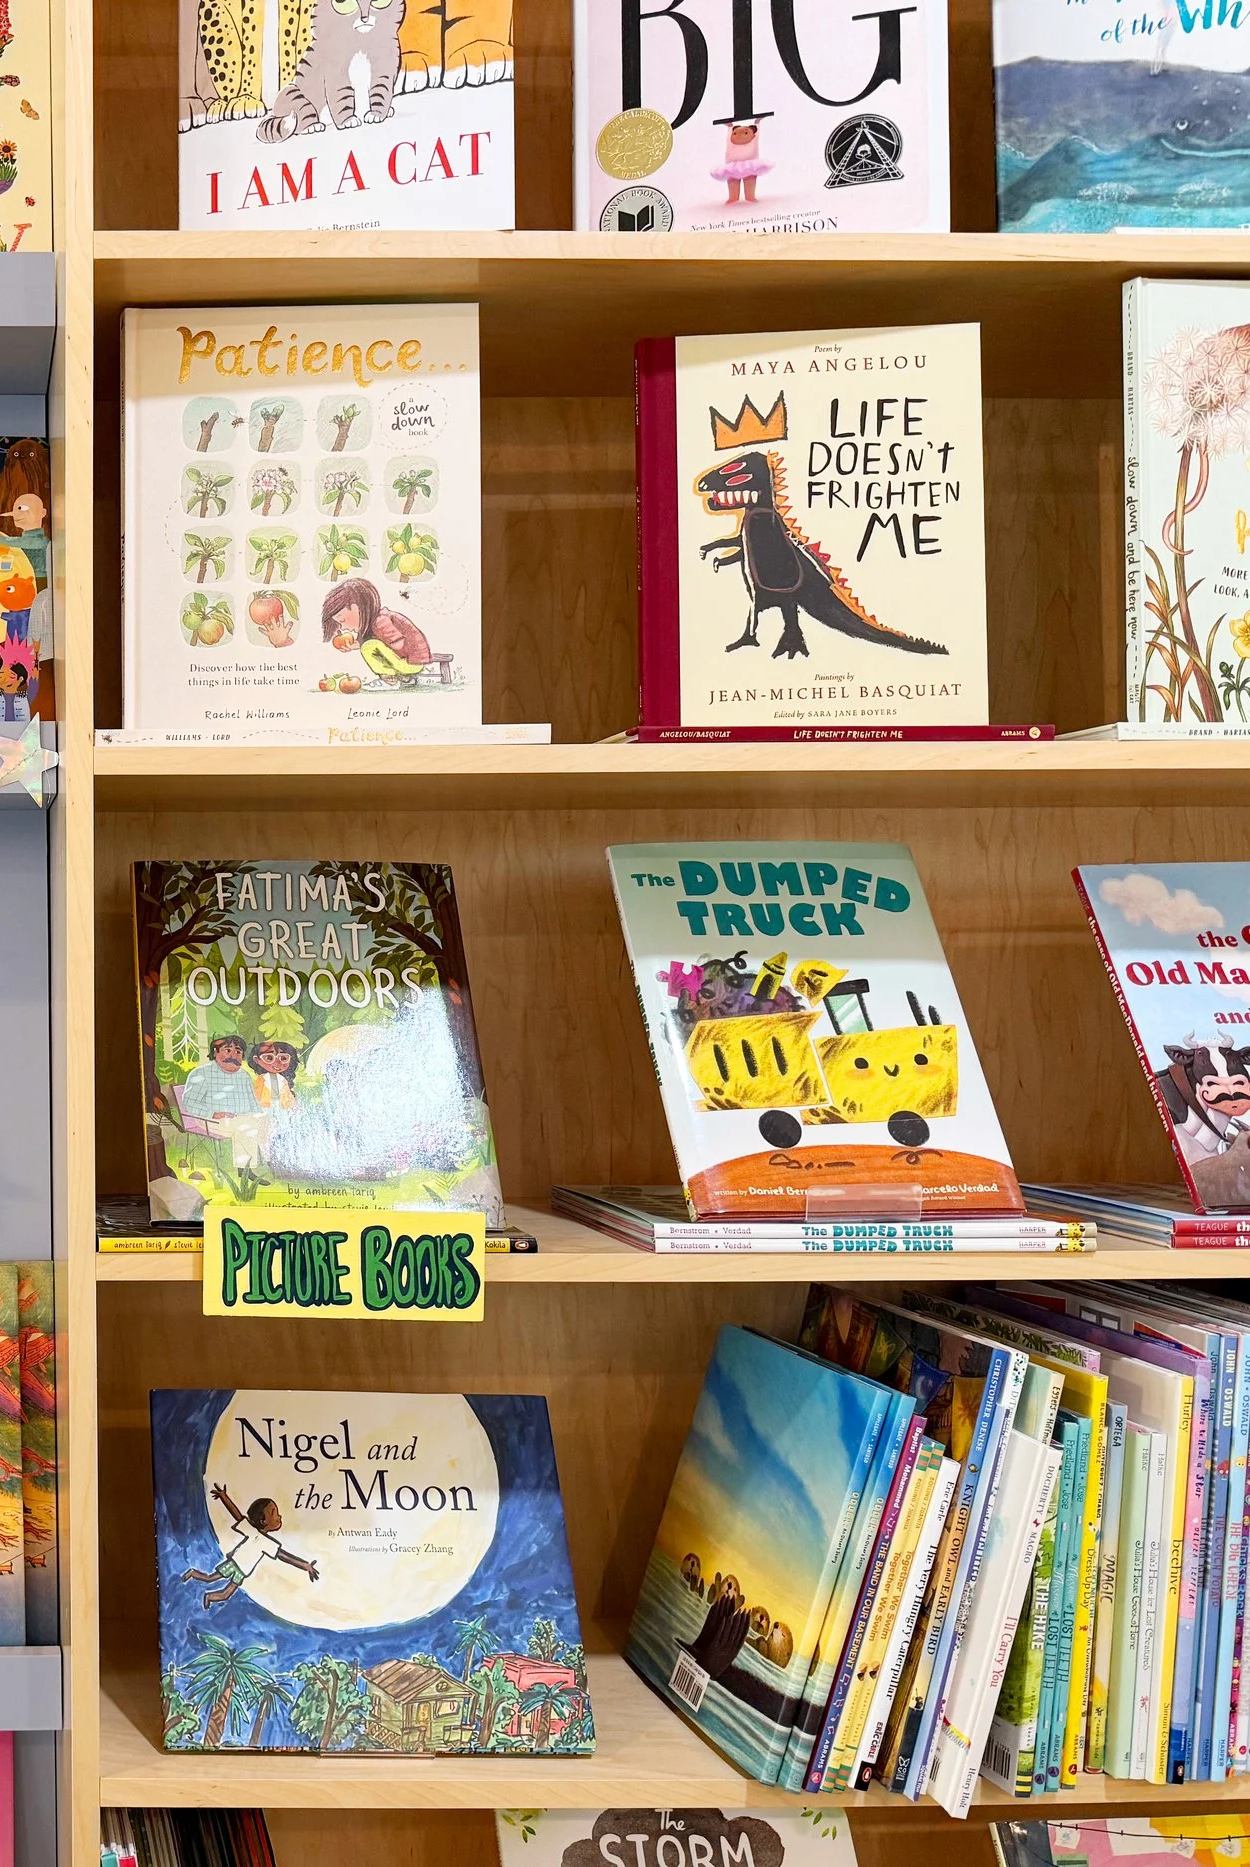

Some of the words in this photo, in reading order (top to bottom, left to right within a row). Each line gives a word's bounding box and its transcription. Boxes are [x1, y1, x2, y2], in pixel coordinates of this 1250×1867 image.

[1100, 18, 1127, 44] of
[1130, 13, 1173, 36] the
[206, 171, 223, 215] I
[237, 157, 318, 212] AM
[332, 149, 370, 195] A
[387, 131, 492, 186] CAT
[631, 189, 656, 199] BOOK
[751, 213, 791, 225] bestselling
[793, 210, 821, 219] creator
[814, 345, 833, 353] Poem
[833, 344, 843, 354] by
[731, 362, 796, 376] MAYA
[808, 355, 928, 373] ANGELOU
[393, 401, 430, 416] slow
[830, 397, 928, 438] LIFE
[391, 414, 435, 431] down
[408, 428, 429, 437] book
[808, 480, 960, 510] FRIGHTEN
[1126, 496, 1139, 537] down
[856, 512, 942, 562] ME
[1126, 542, 1141, 566] and
[1221, 566, 1249, 581] MORE
[189, 663, 233, 673] Discover
[188, 677, 219, 688] things
[708, 686, 850, 705] JEAN-MICHEL
[859, 683, 963, 700] BASQUIAT
[204, 709, 240, 720] Rachel
[347, 706, 381, 720] Leonie
[386, 706, 409, 720] Lord
[834, 709, 859, 718] JANE
[860, 708, 899, 717] BOYERS
[793, 730, 813, 740] LIFE
[847, 730, 888, 740] FRIGHTEN
[214, 871, 387, 913] FATIMA'S
[630, 873, 676, 887] The
[678, 860, 912, 913] DUMPED
[676, 901, 865, 937] TRUCK
[237, 919, 369, 962] GREAT
[1196, 930, 1239, 948] the
[1109, 973, 1120, 994] Old
[1125, 960, 1193, 986] Old
[187, 967, 425, 1010] OUTDOORS
[287, 1183, 300, 1199] by
[305, 1184, 348, 1197] ambreen
[958, 1183, 999, 1194] Verdad
[802, 1226, 828, 1236] The
[832, 1225, 898, 1238] DUMPED
[902, 1225, 954, 1237] TRUCK
[1194, 1222, 1229, 1231] TEAGUE
[114, 1240, 143, 1249] ambreen
[174, 1240, 193, 1249] stevie
[485, 1241, 506, 1249] Kokila
[670, 1241, 711, 1250] Bernstrom
[802, 1240, 828, 1251] The
[832, 1240, 898, 1252] DUMPED
[902, 1240, 954, 1252] TRUCK
[1193, 1237, 1227, 1246] TEAGUE
[220, 1218, 353, 1308] PICTURE
[360, 1225, 481, 1311] BOOKS
[985, 1358, 1003, 1418] CHRISTOPHER
[1179, 1394, 1193, 1433] Hurley
[1223, 1388, 1234, 1427] OSWALD
[975, 1421, 989, 1452] DENISE
[1112, 1415, 1124, 1447] ORTEGA
[235, 1417, 356, 1473] Nigel
[367, 1436, 418, 1461] and
[294, 1483, 333, 1510] the
[338, 1469, 478, 1512] Moon
[1037, 1465, 1055, 1516] DOCHERTY
[1195, 1473, 1205, 1498] Star
[956, 1482, 974, 1536] KNIGHT
[336, 1527, 372, 1538] Antwan
[389, 1543, 422, 1554] Gracey
[424, 1543, 454, 1555] Zhang
[870, 1559, 884, 1588] BAND
[1100, 1555, 1116, 1604] MAGIC
[1168, 1539, 1183, 1595] beehive
[936, 1583, 951, 1624] EARLY
[845, 1617, 866, 1671] BASEMENT
[927, 1626, 941, 1656] BIRD
[994, 1632, 1013, 1665] Carry
[990, 1669, 1006, 1688] You
[1161, 1703, 1170, 1724] Simon
[817, 1738, 831, 1769] ABRAMS
[1157, 1732, 1169, 1776] Schuster
[962, 1767, 976, 1792] Henry
[959, 1791, 970, 1808] Holt
[655, 1808, 688, 1831] The
